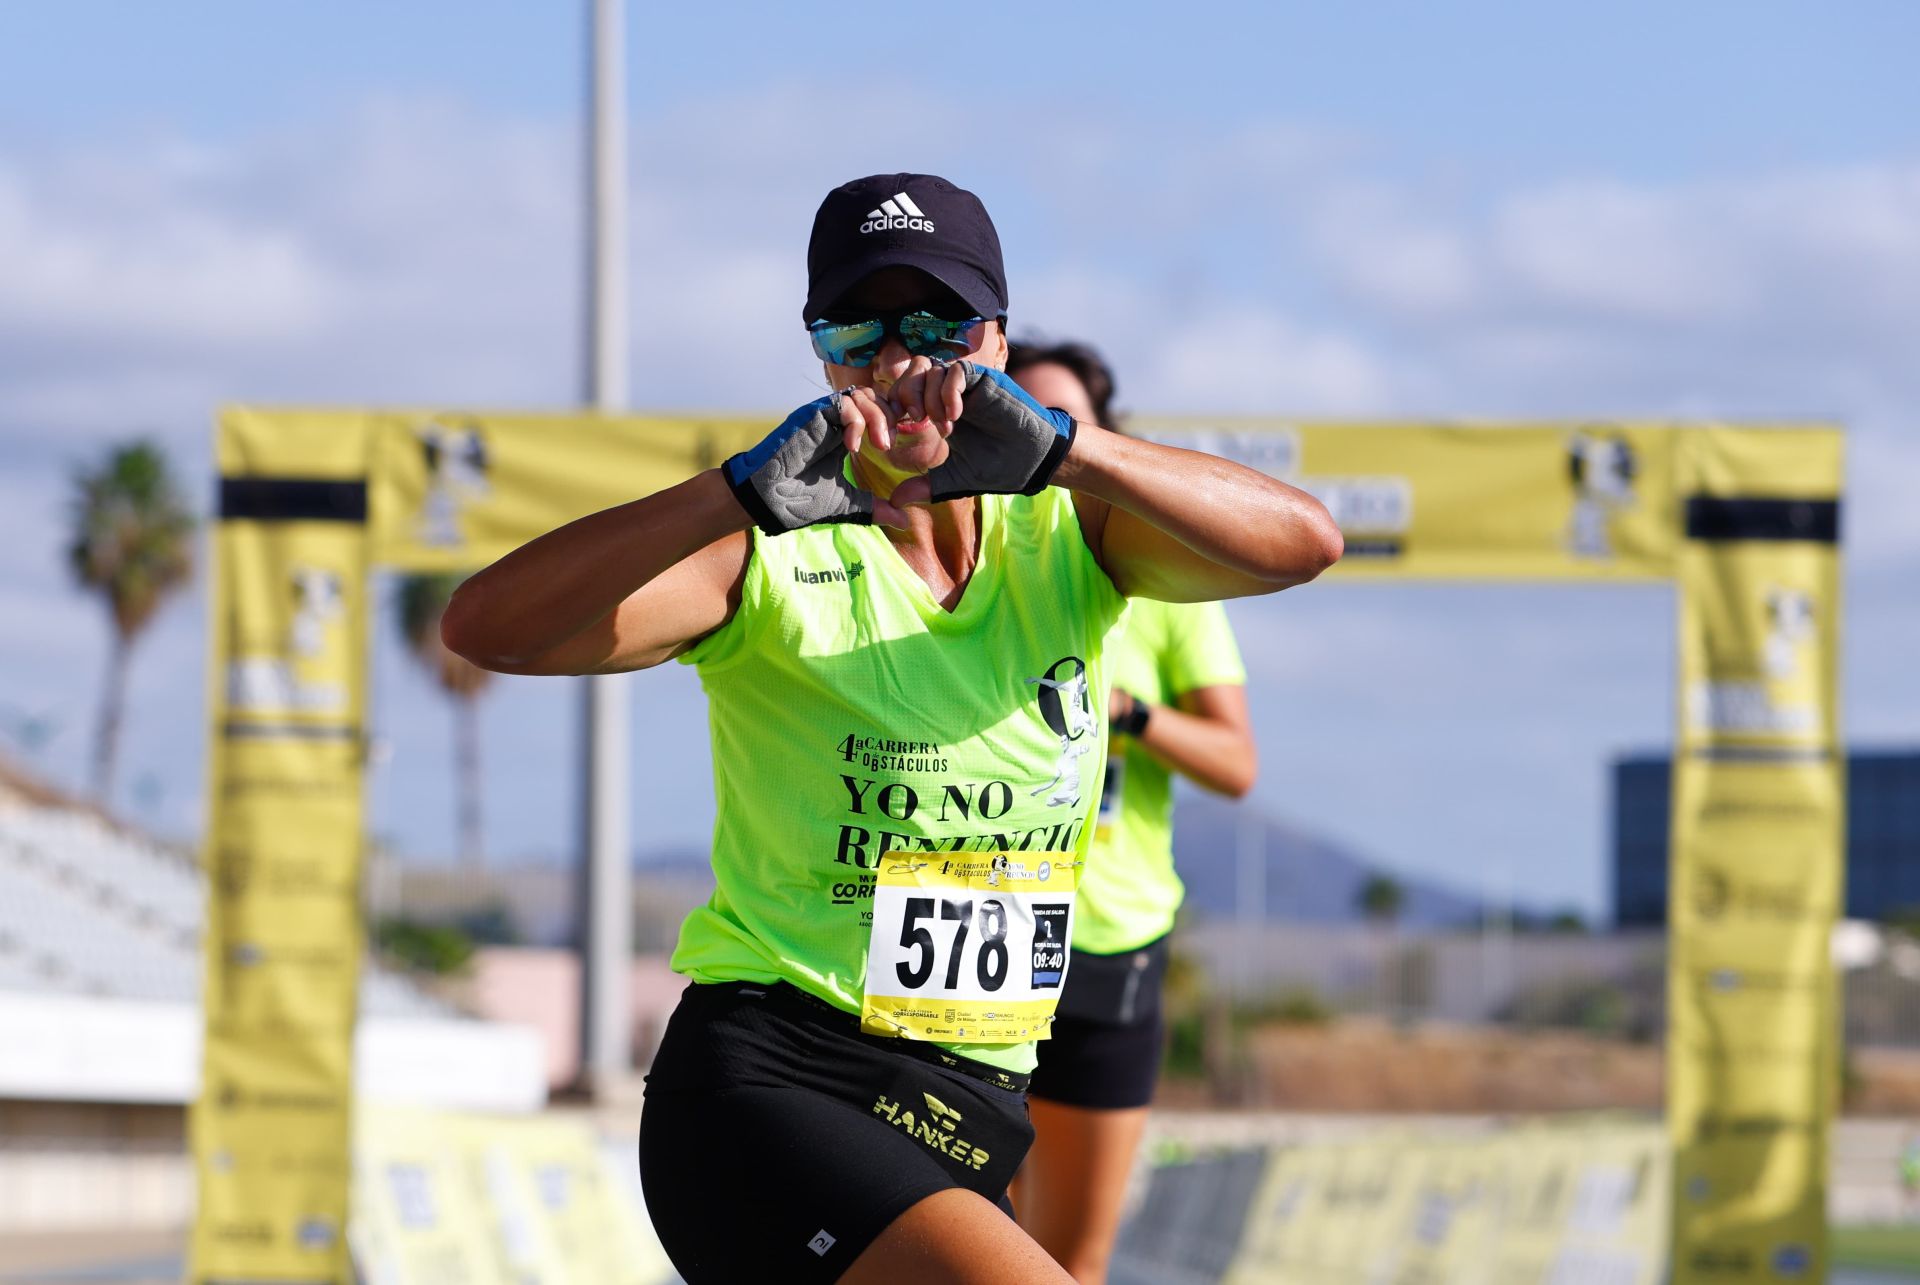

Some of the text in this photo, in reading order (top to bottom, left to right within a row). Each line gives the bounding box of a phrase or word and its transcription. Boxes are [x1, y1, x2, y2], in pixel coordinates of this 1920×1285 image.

[859, 215, 935, 234] adidas
[794, 566, 846, 584] luanvi
[864, 737, 939, 754] CARRERA
[862, 753, 948, 772] OBSTÁCULOS
[840, 774, 1013, 822] YO NO
[1044, 920, 1052, 938] 2
[896, 897, 1009, 992] 578
[1033, 952, 1063, 969] 09:40
[873, 1095, 990, 1171] HANKER
